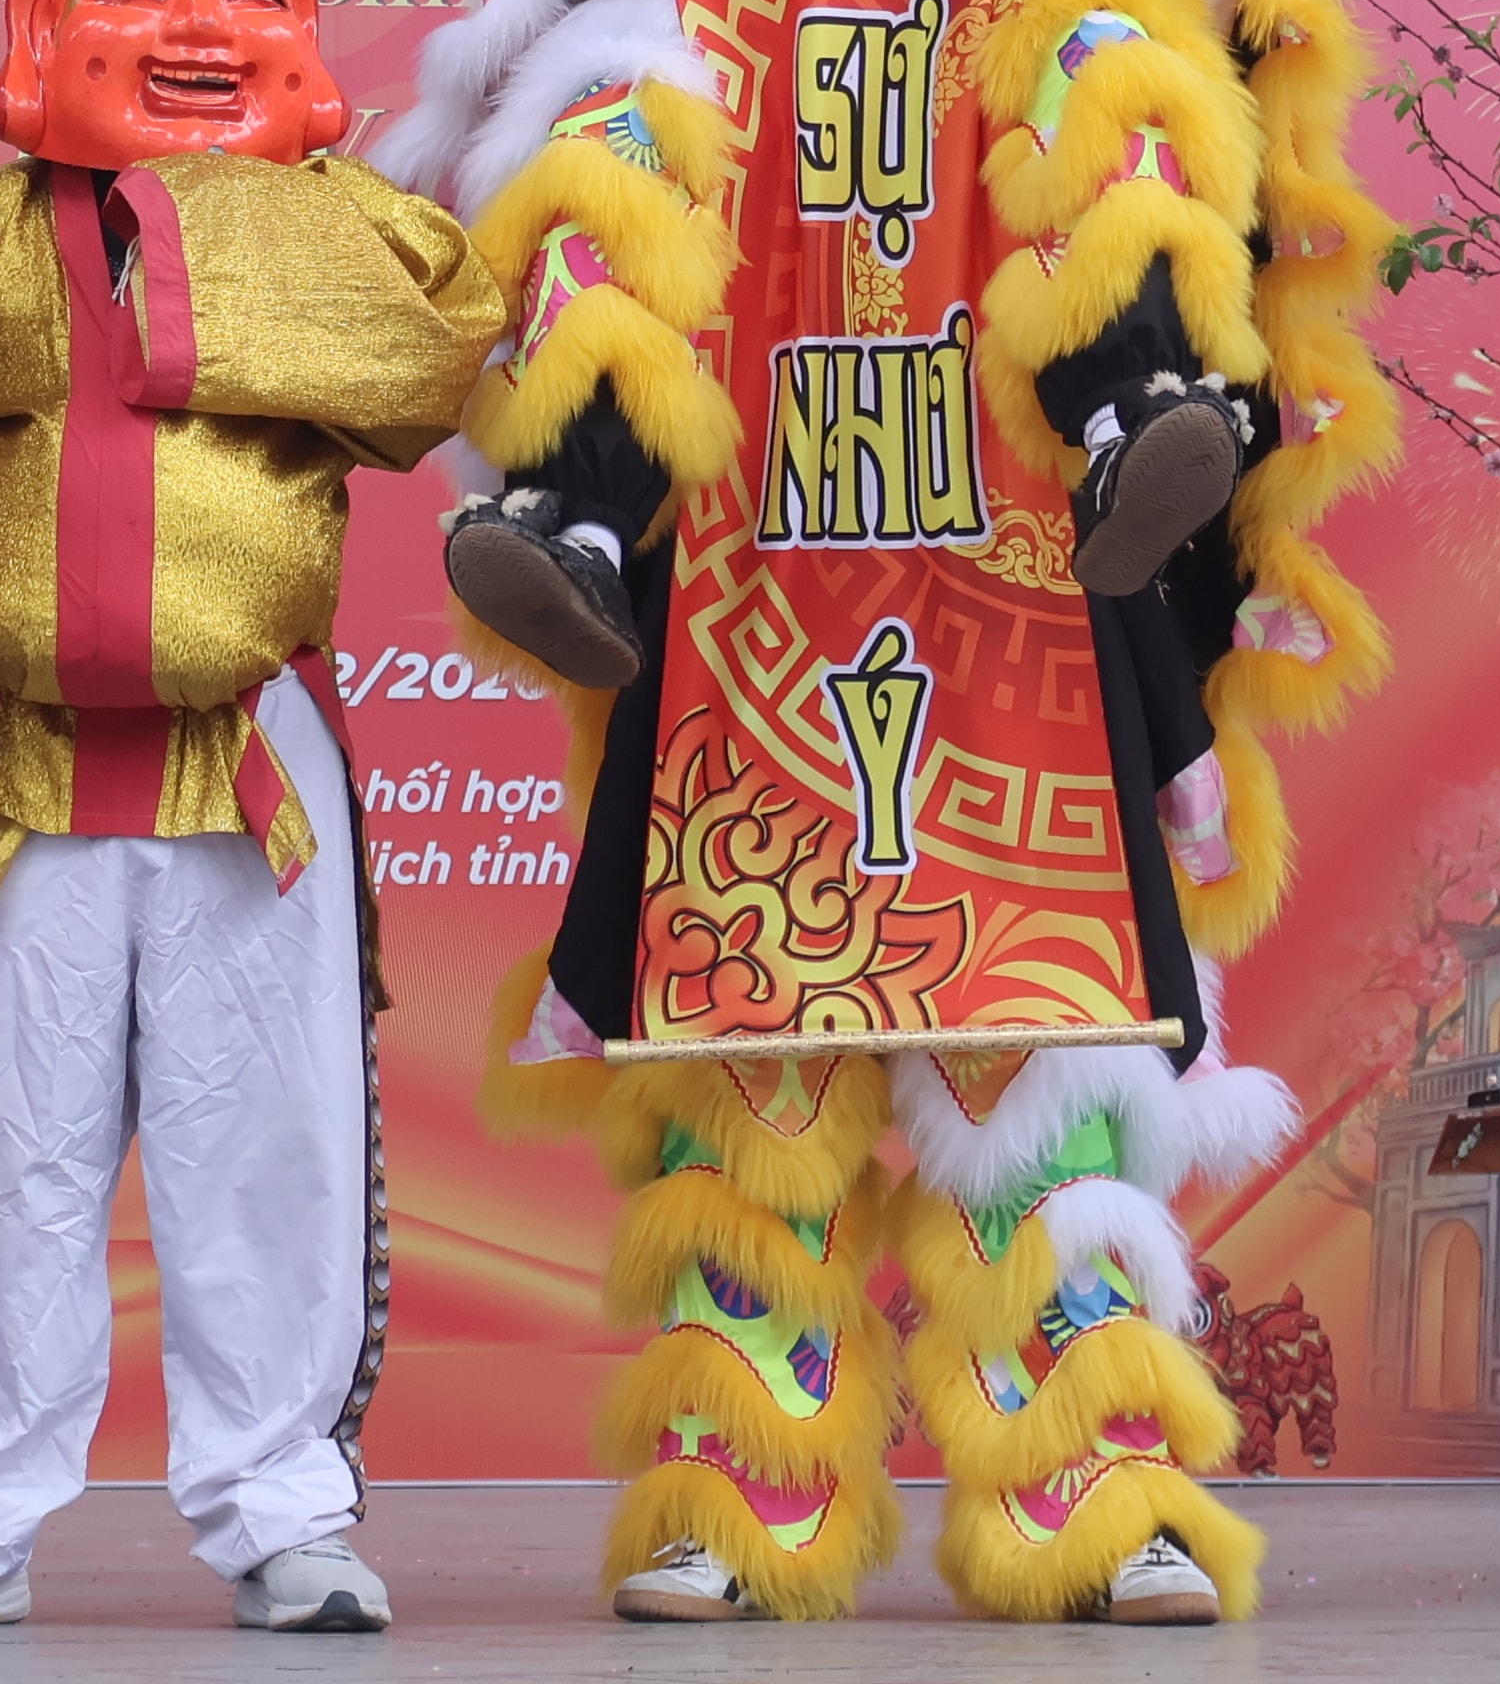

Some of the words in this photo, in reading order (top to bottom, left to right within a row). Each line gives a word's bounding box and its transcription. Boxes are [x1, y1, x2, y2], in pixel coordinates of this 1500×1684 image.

[759, 309, 985, 543] NHƯ
[358, 760, 452, 814] hối
[460, 768, 565, 825] hợp
[826, 625, 928, 868] Ý
[468, 834, 570, 886] tỉnh
